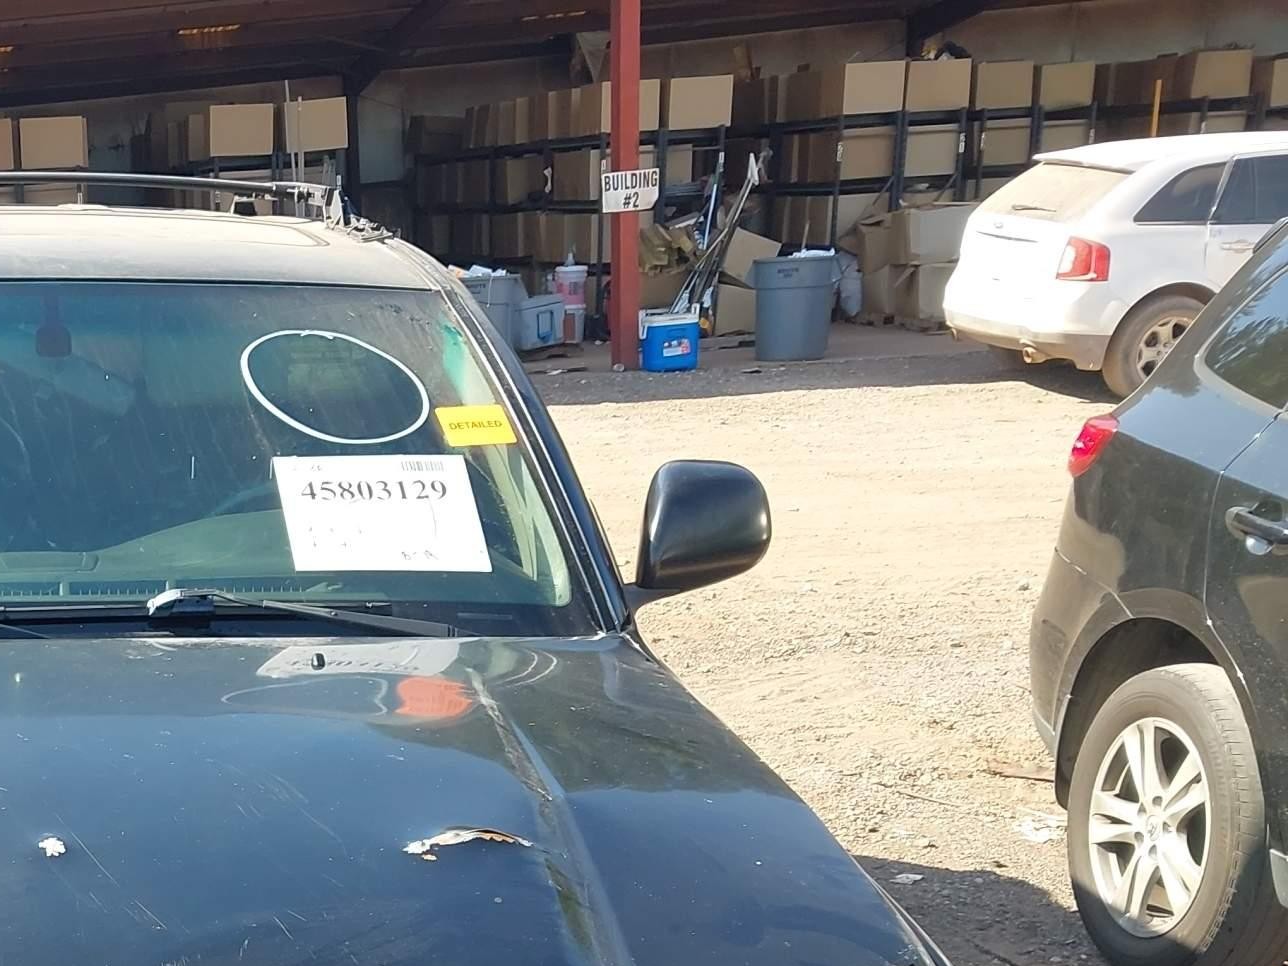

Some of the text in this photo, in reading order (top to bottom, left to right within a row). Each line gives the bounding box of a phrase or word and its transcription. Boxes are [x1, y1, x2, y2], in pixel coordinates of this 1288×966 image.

[604, 170, 658, 192] BUILDING
[623, 192, 640, 209] #2
[448, 420, 503, 430] DETAILED
[301, 479, 447, 501] 45803129
